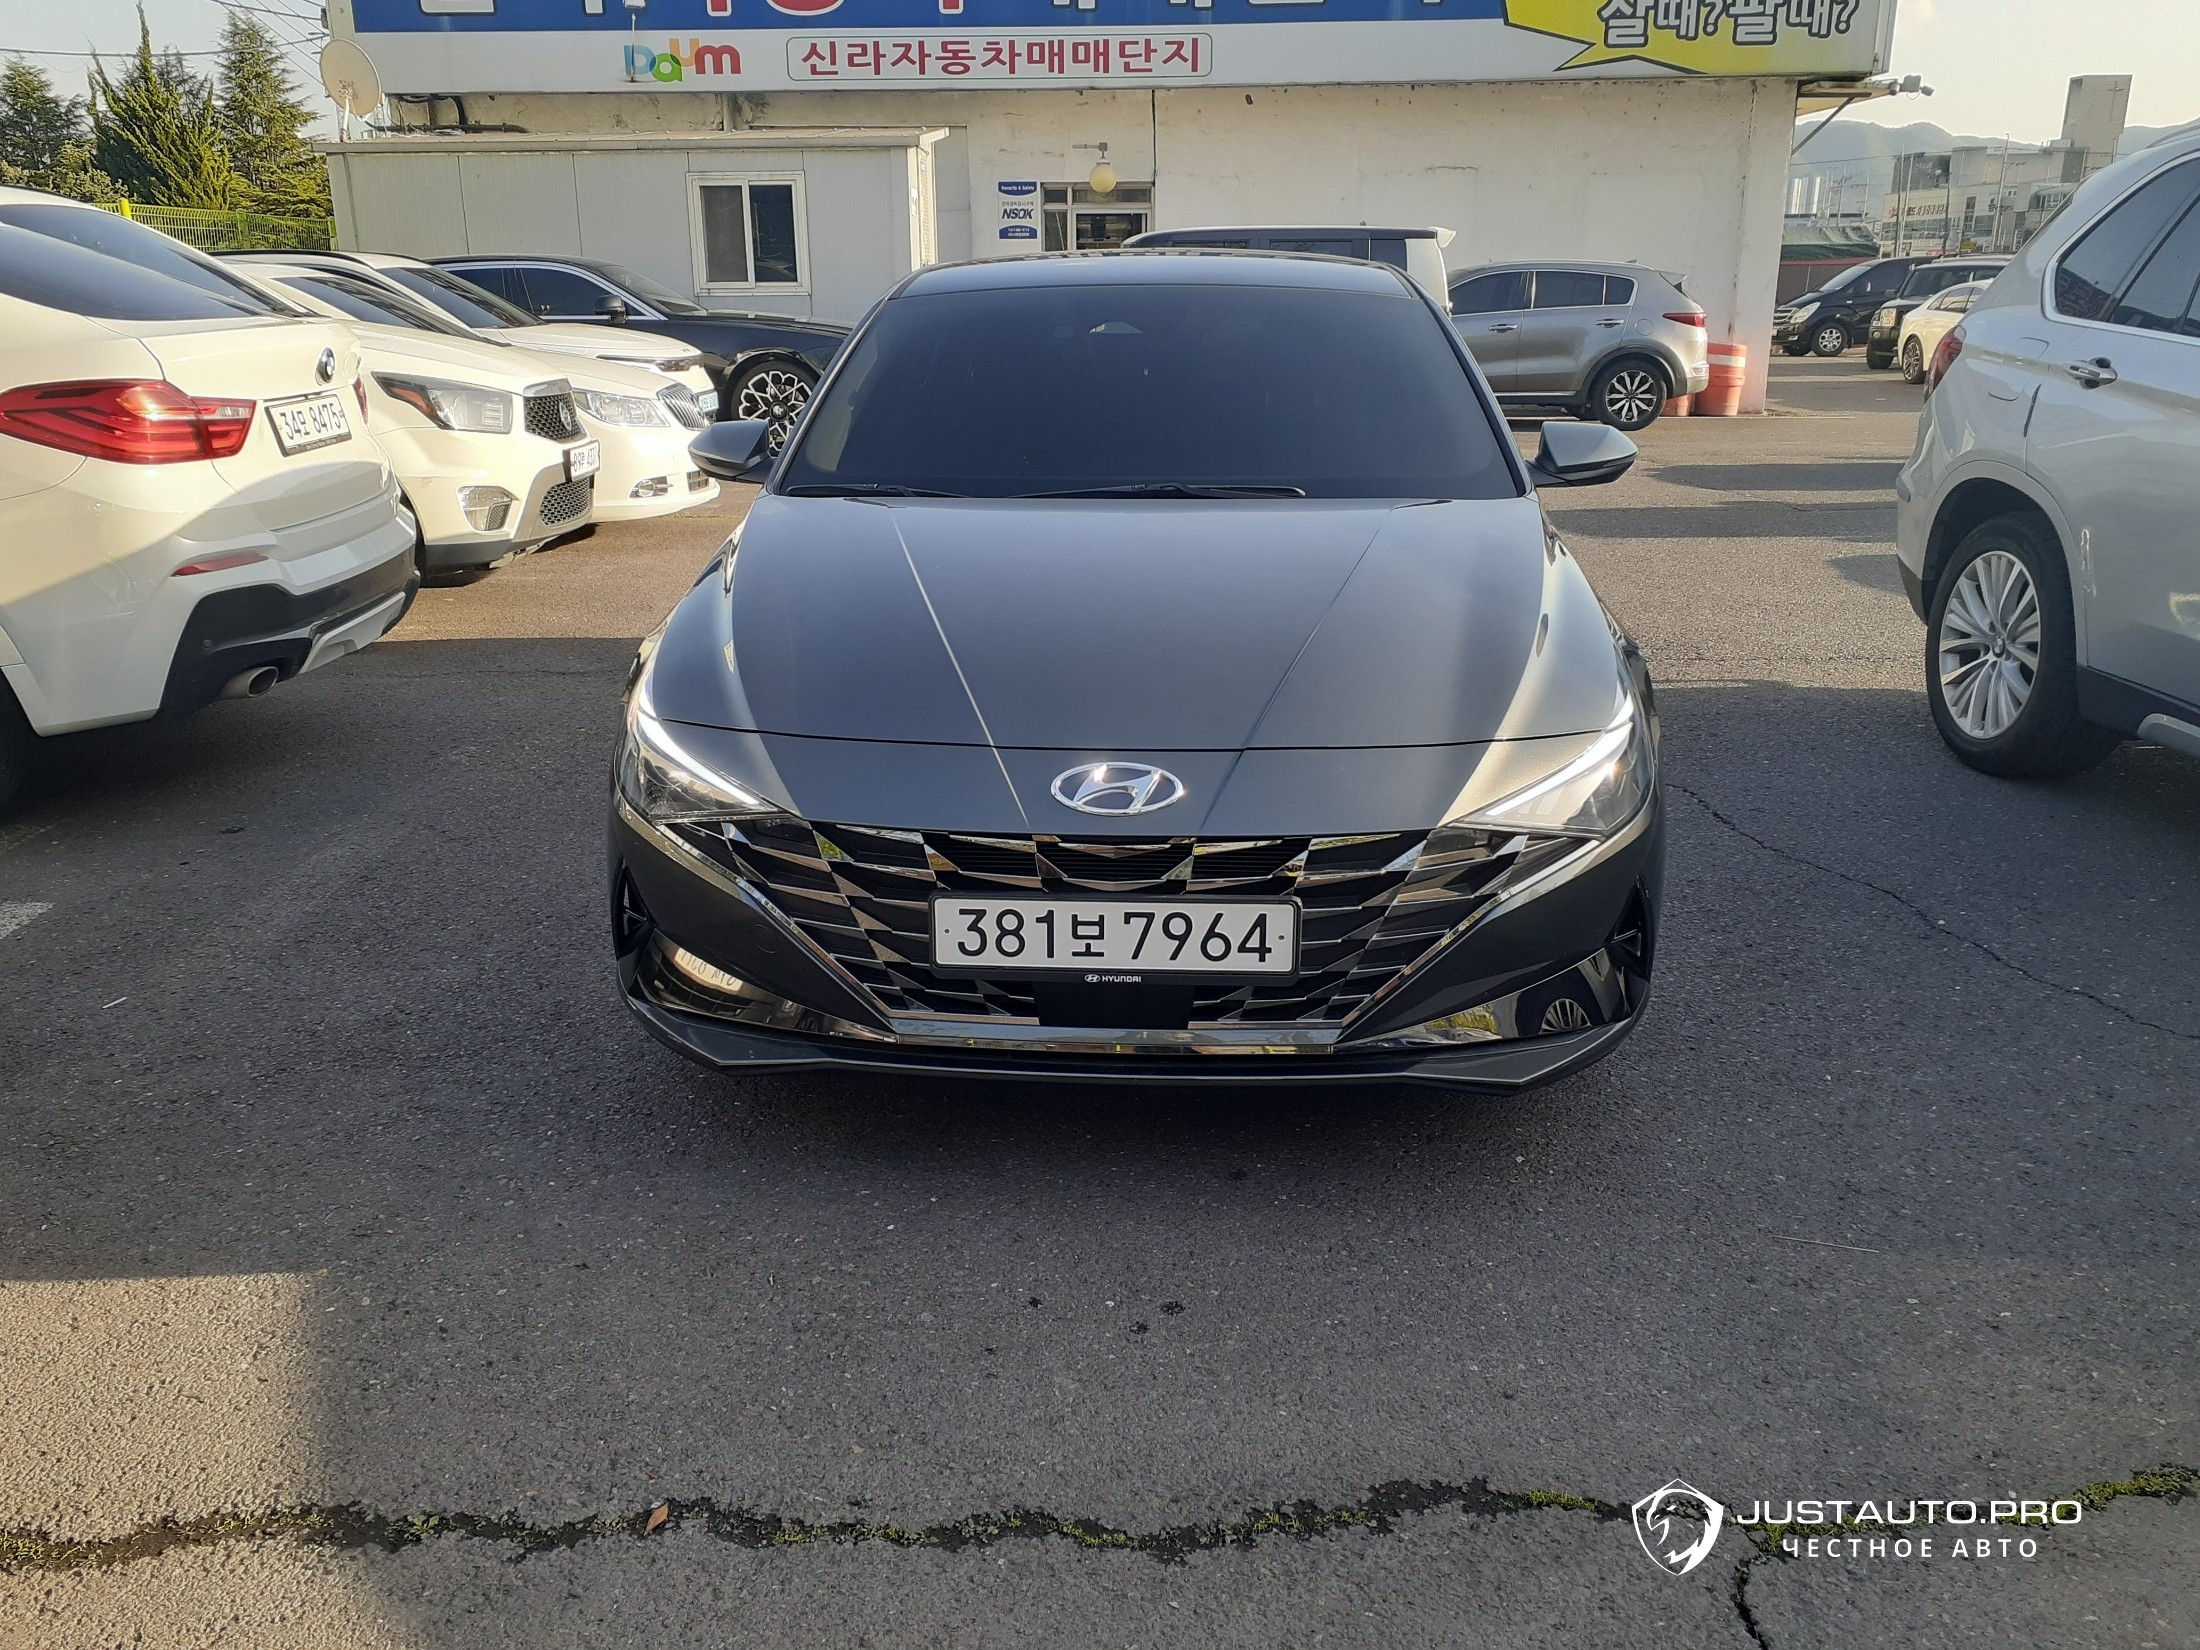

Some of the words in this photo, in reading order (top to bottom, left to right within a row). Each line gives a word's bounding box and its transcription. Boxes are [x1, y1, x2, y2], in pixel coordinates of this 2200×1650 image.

[801, 37, 1200, 76] 신라자동차매매단지
[1001, 208, 1035, 220] NSOK
[308, 402, 341, 433] 8475
[957, 908, 1105, 960] 381보
[1123, 911, 1273, 963] 7964
[1101, 975, 1142, 983] HYUNDAI
